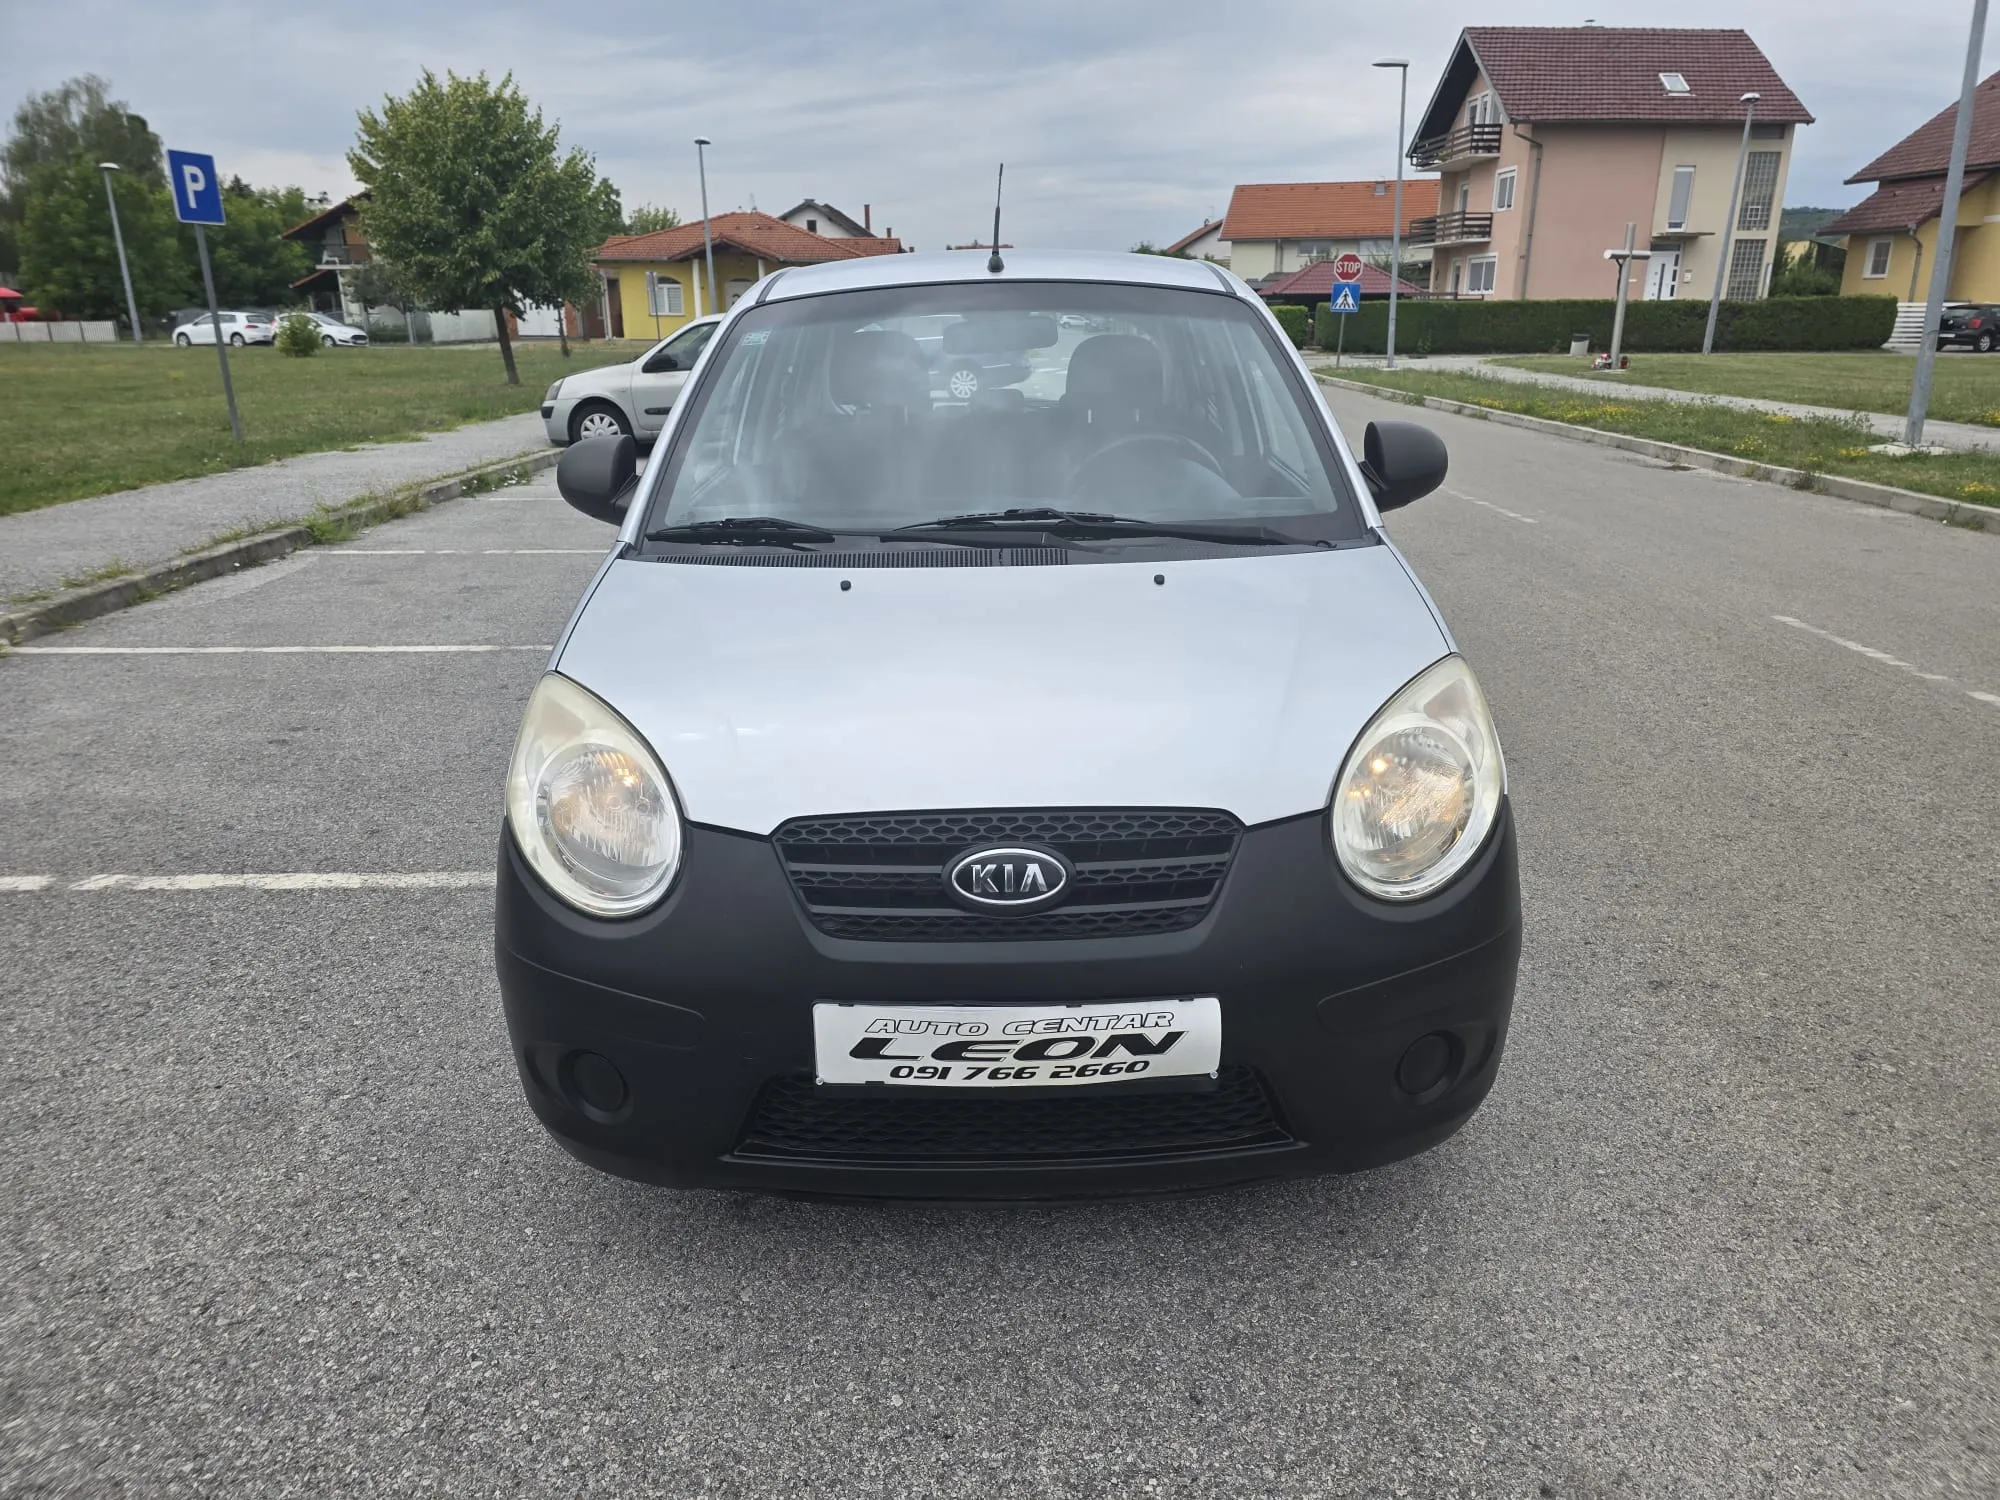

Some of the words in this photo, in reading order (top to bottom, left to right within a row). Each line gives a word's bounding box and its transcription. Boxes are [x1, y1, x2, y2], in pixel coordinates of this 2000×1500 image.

[182, 164, 206, 209] P
[1336, 261, 1361, 273] STOP
[971, 863, 1048, 893] KIA
[865, 1018, 989, 1037] AUTO
[1002, 1012, 1175, 1036] CENTAR
[849, 1031, 1190, 1063] LEON
[890, 1065, 952, 1080] 091
[962, 1066, 1040, 1081] 766
[1049, 1060, 1150, 1080] 2660
